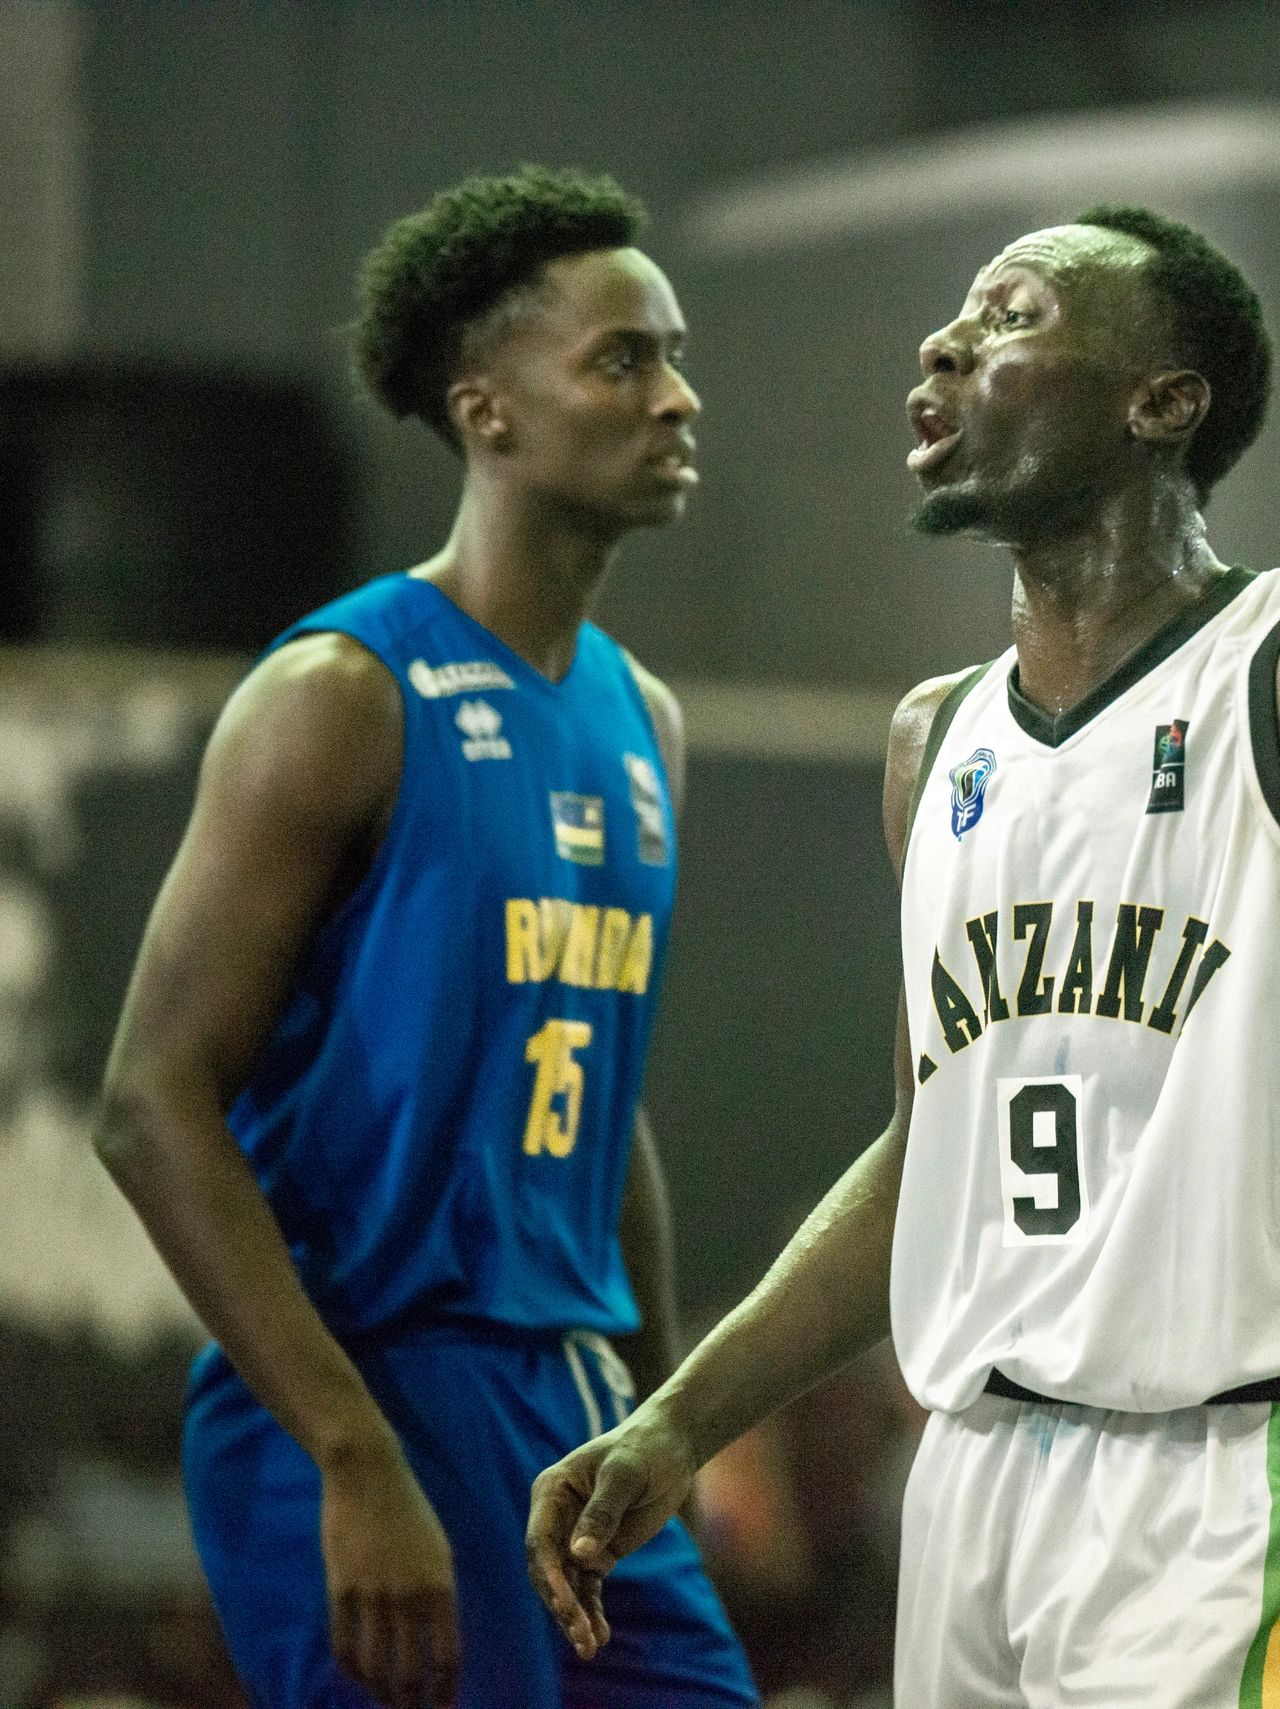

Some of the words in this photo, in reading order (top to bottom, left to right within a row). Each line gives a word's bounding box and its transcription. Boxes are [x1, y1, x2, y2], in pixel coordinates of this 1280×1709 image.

[918, 900, 1232, 1084] ANZANI
[523, 1019, 592, 1158] 15
[1009, 1084, 1082, 1235] 9
